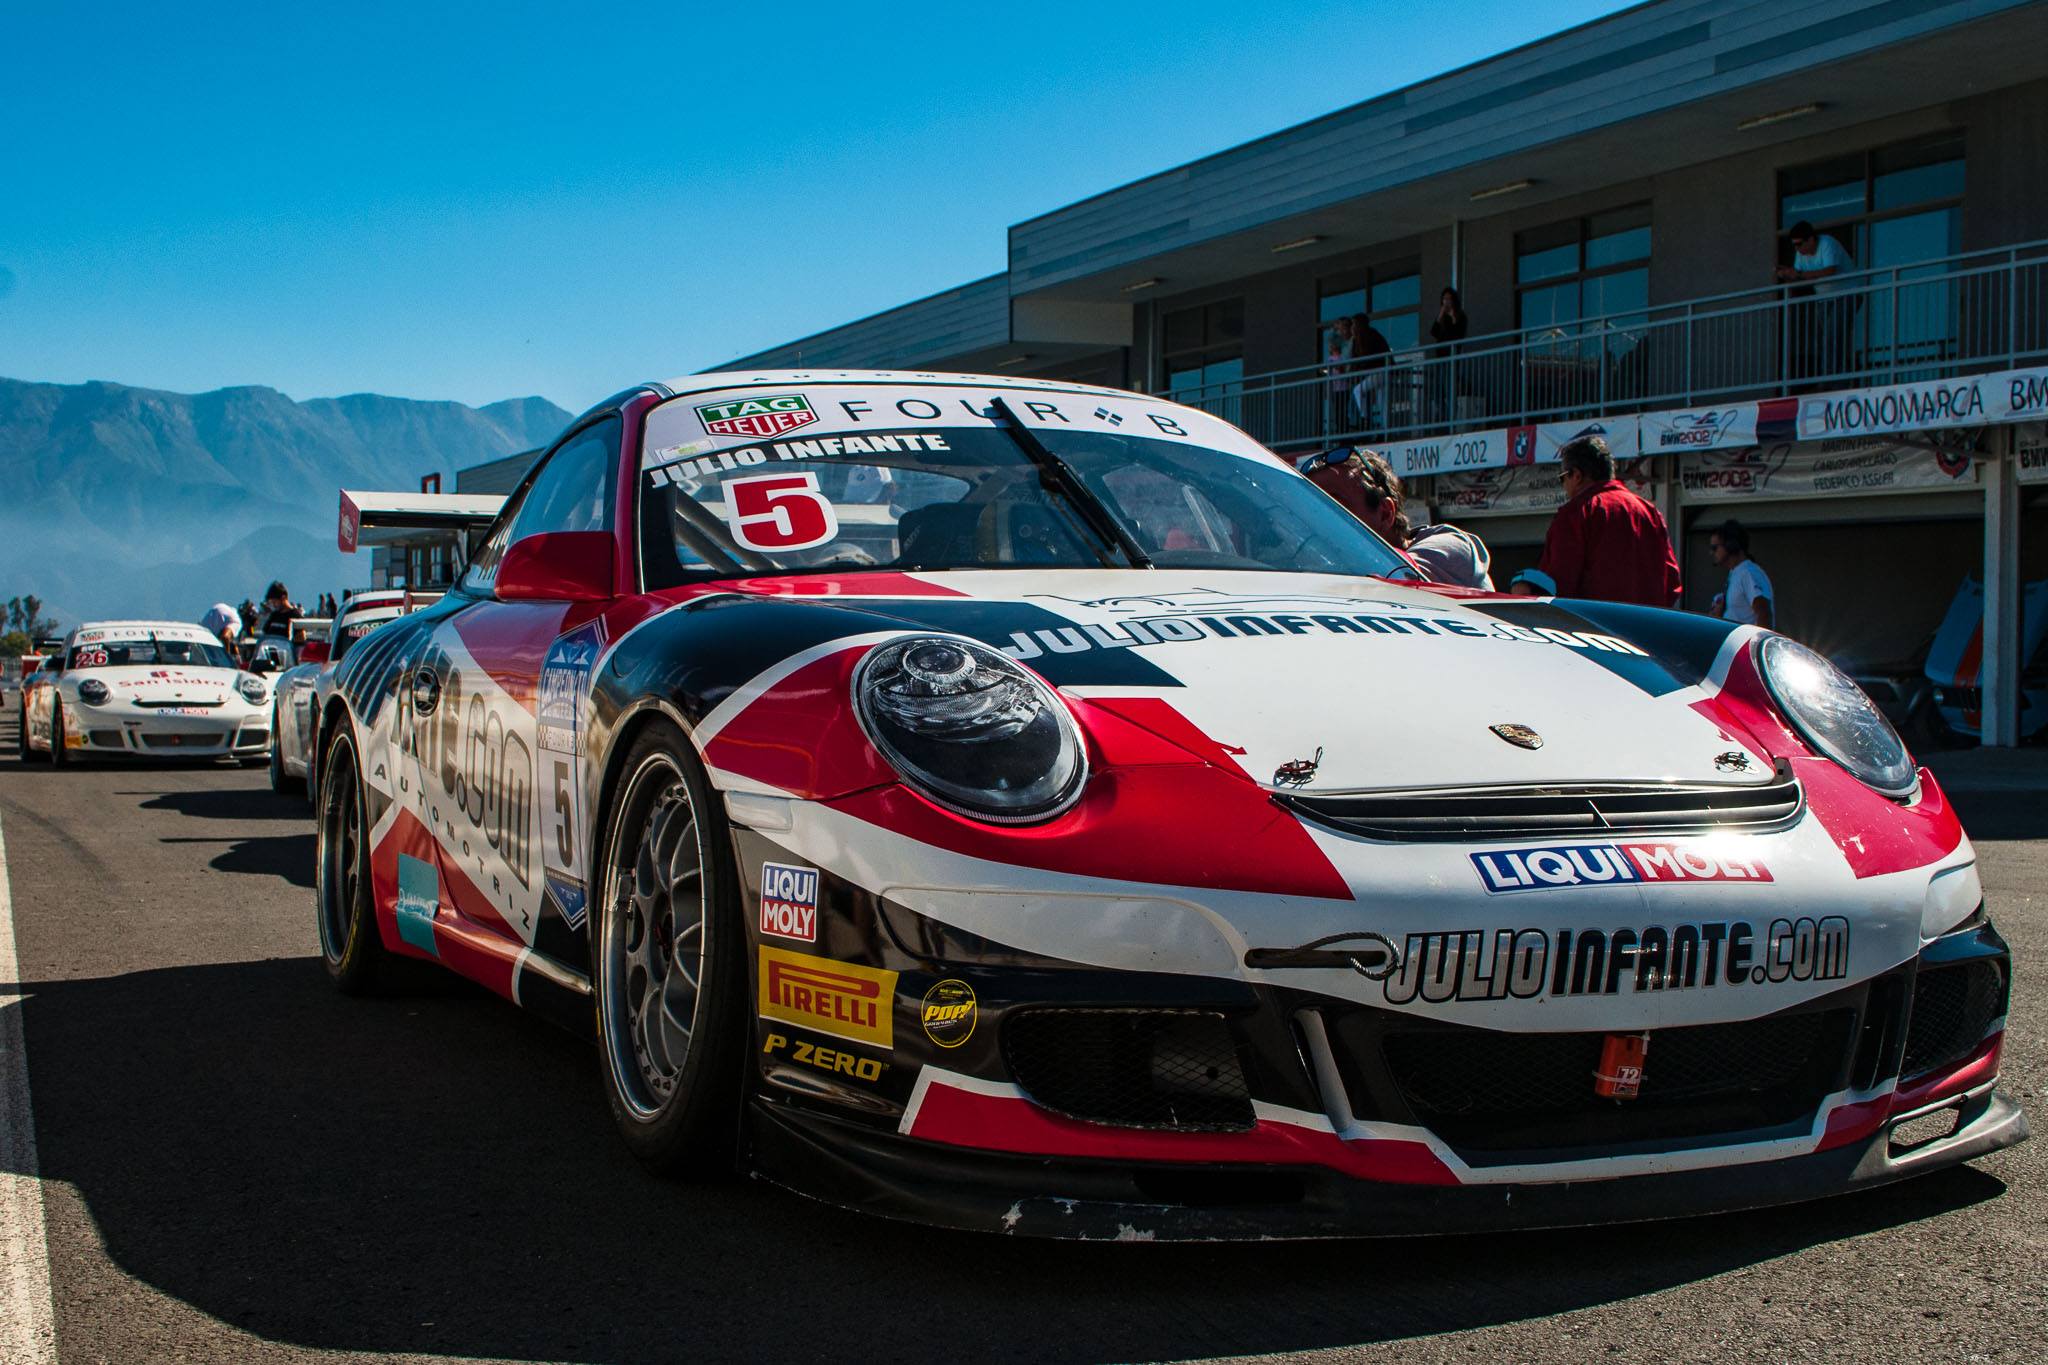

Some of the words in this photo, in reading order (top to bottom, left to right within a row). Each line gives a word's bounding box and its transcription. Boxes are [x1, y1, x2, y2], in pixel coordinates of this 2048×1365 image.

[707, 397, 799, 419] TAG
[1824, 385, 1984, 432] MONOMARCA
[2009, 374, 2048, 411] BM
[711, 411, 811, 437] HEUER
[650, 447, 768, 489] JULIO
[772, 434, 952, 462] INFANTE
[1406, 446, 1440, 471] BMW
[1453, 440, 1488, 466] 2002
[726, 474, 834, 550] 5
[76, 650, 109, 668] 26
[553, 760, 574, 868] 5
[374, 763, 531, 932] AUTOMOTRIZ
[1478, 848, 1635, 888] LIQUI
[1634, 845, 1766, 880] MOLY
[763, 868, 815, 903] LIQUI
[763, 901, 815, 936] MOLY
[767, 960, 881, 1029] PIRELLI
[763, 1033, 788, 1054] P
